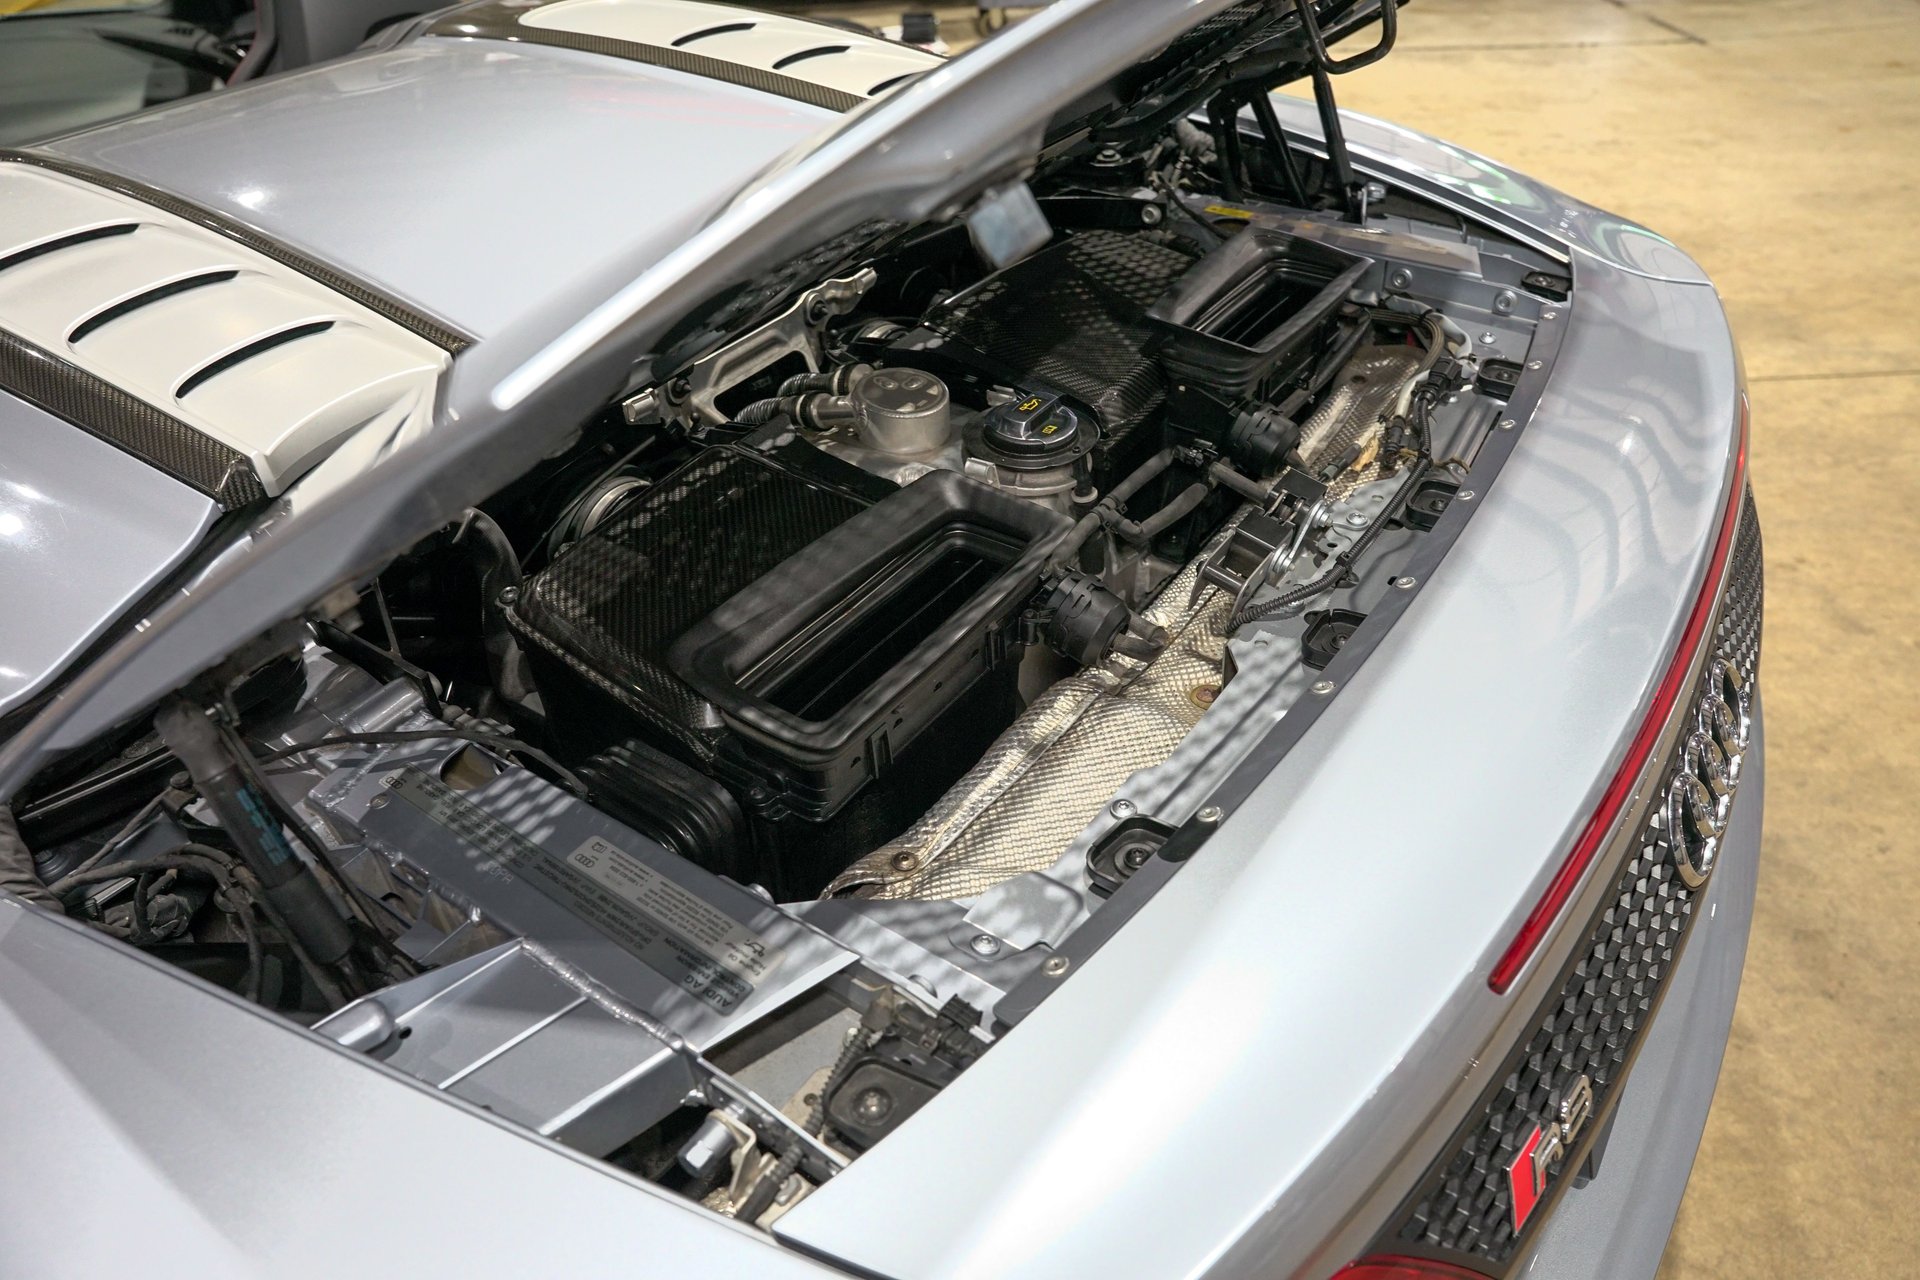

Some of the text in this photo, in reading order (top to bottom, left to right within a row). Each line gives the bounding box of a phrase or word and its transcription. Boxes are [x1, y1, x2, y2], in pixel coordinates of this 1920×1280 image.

[662, 934, 746, 994] CONTROL INFORMATION
[682, 972, 733, 1010] AUDI AG
